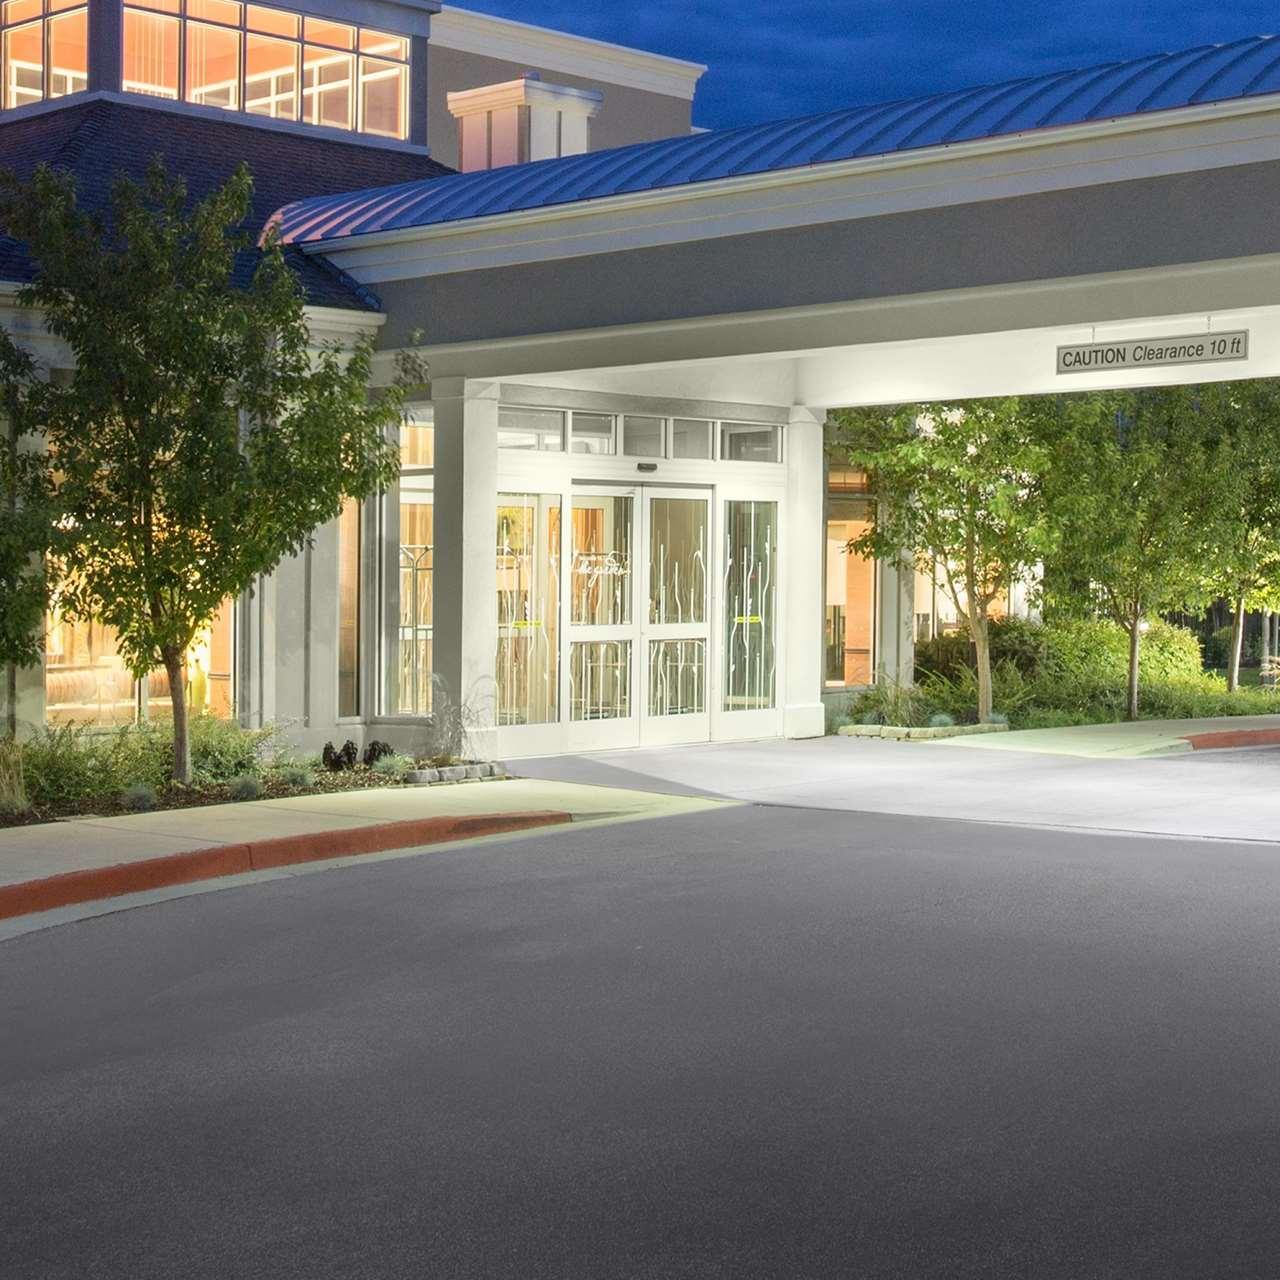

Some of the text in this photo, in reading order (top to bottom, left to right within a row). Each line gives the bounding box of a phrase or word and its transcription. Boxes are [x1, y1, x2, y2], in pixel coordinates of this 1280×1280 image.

[1062, 337, 1241, 367] CAUTION Clearance 10 ft
